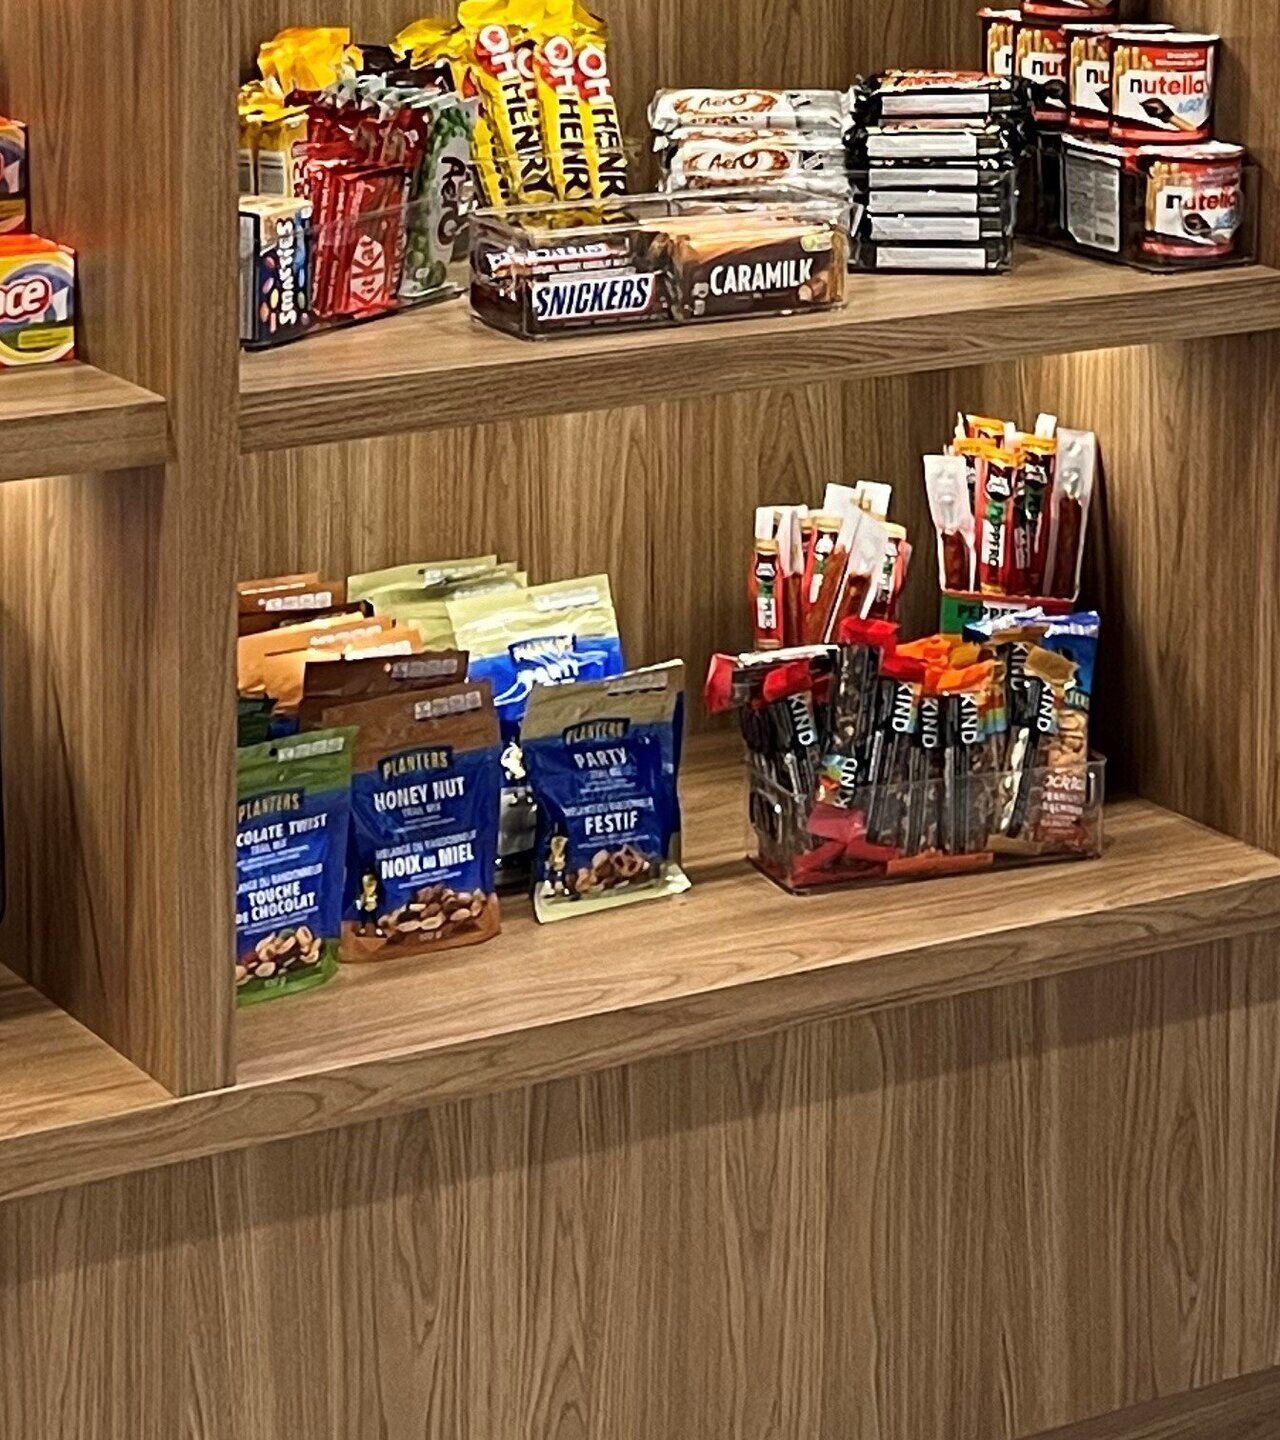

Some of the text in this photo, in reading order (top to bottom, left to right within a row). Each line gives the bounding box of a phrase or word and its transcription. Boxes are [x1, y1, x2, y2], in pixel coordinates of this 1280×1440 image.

[544, 36, 580, 96] OH
[578, 45, 615, 106] OH
[1129, 74, 1206, 95] nutella
[479, 25, 557, 198] OH HENRY
[709, 258, 814, 297] CARAMILK
[535, 277, 650, 319] SNICKERS
[787, 692, 816, 746] KIND
[891, 681, 914, 732] KIND
[922, 696, 939, 748] KIND
[961, 692, 978, 744] KIND
[382, 751, 448, 781] PLANTERS
[573, 746, 627, 769] PARTY
[238, 792, 300, 823] PLANTERS
[373, 776, 465, 812] HONEY NUT
[235, 812, 328, 848] COLATE TWIST
[584, 810, 638, 836] FESTIF
[381, 854, 423, 880] NOIX
[437, 843, 475, 868] MIEL
[247, 880, 301, 907] TOUCHE
[251, 891, 316, 921] CHOCOLAT
